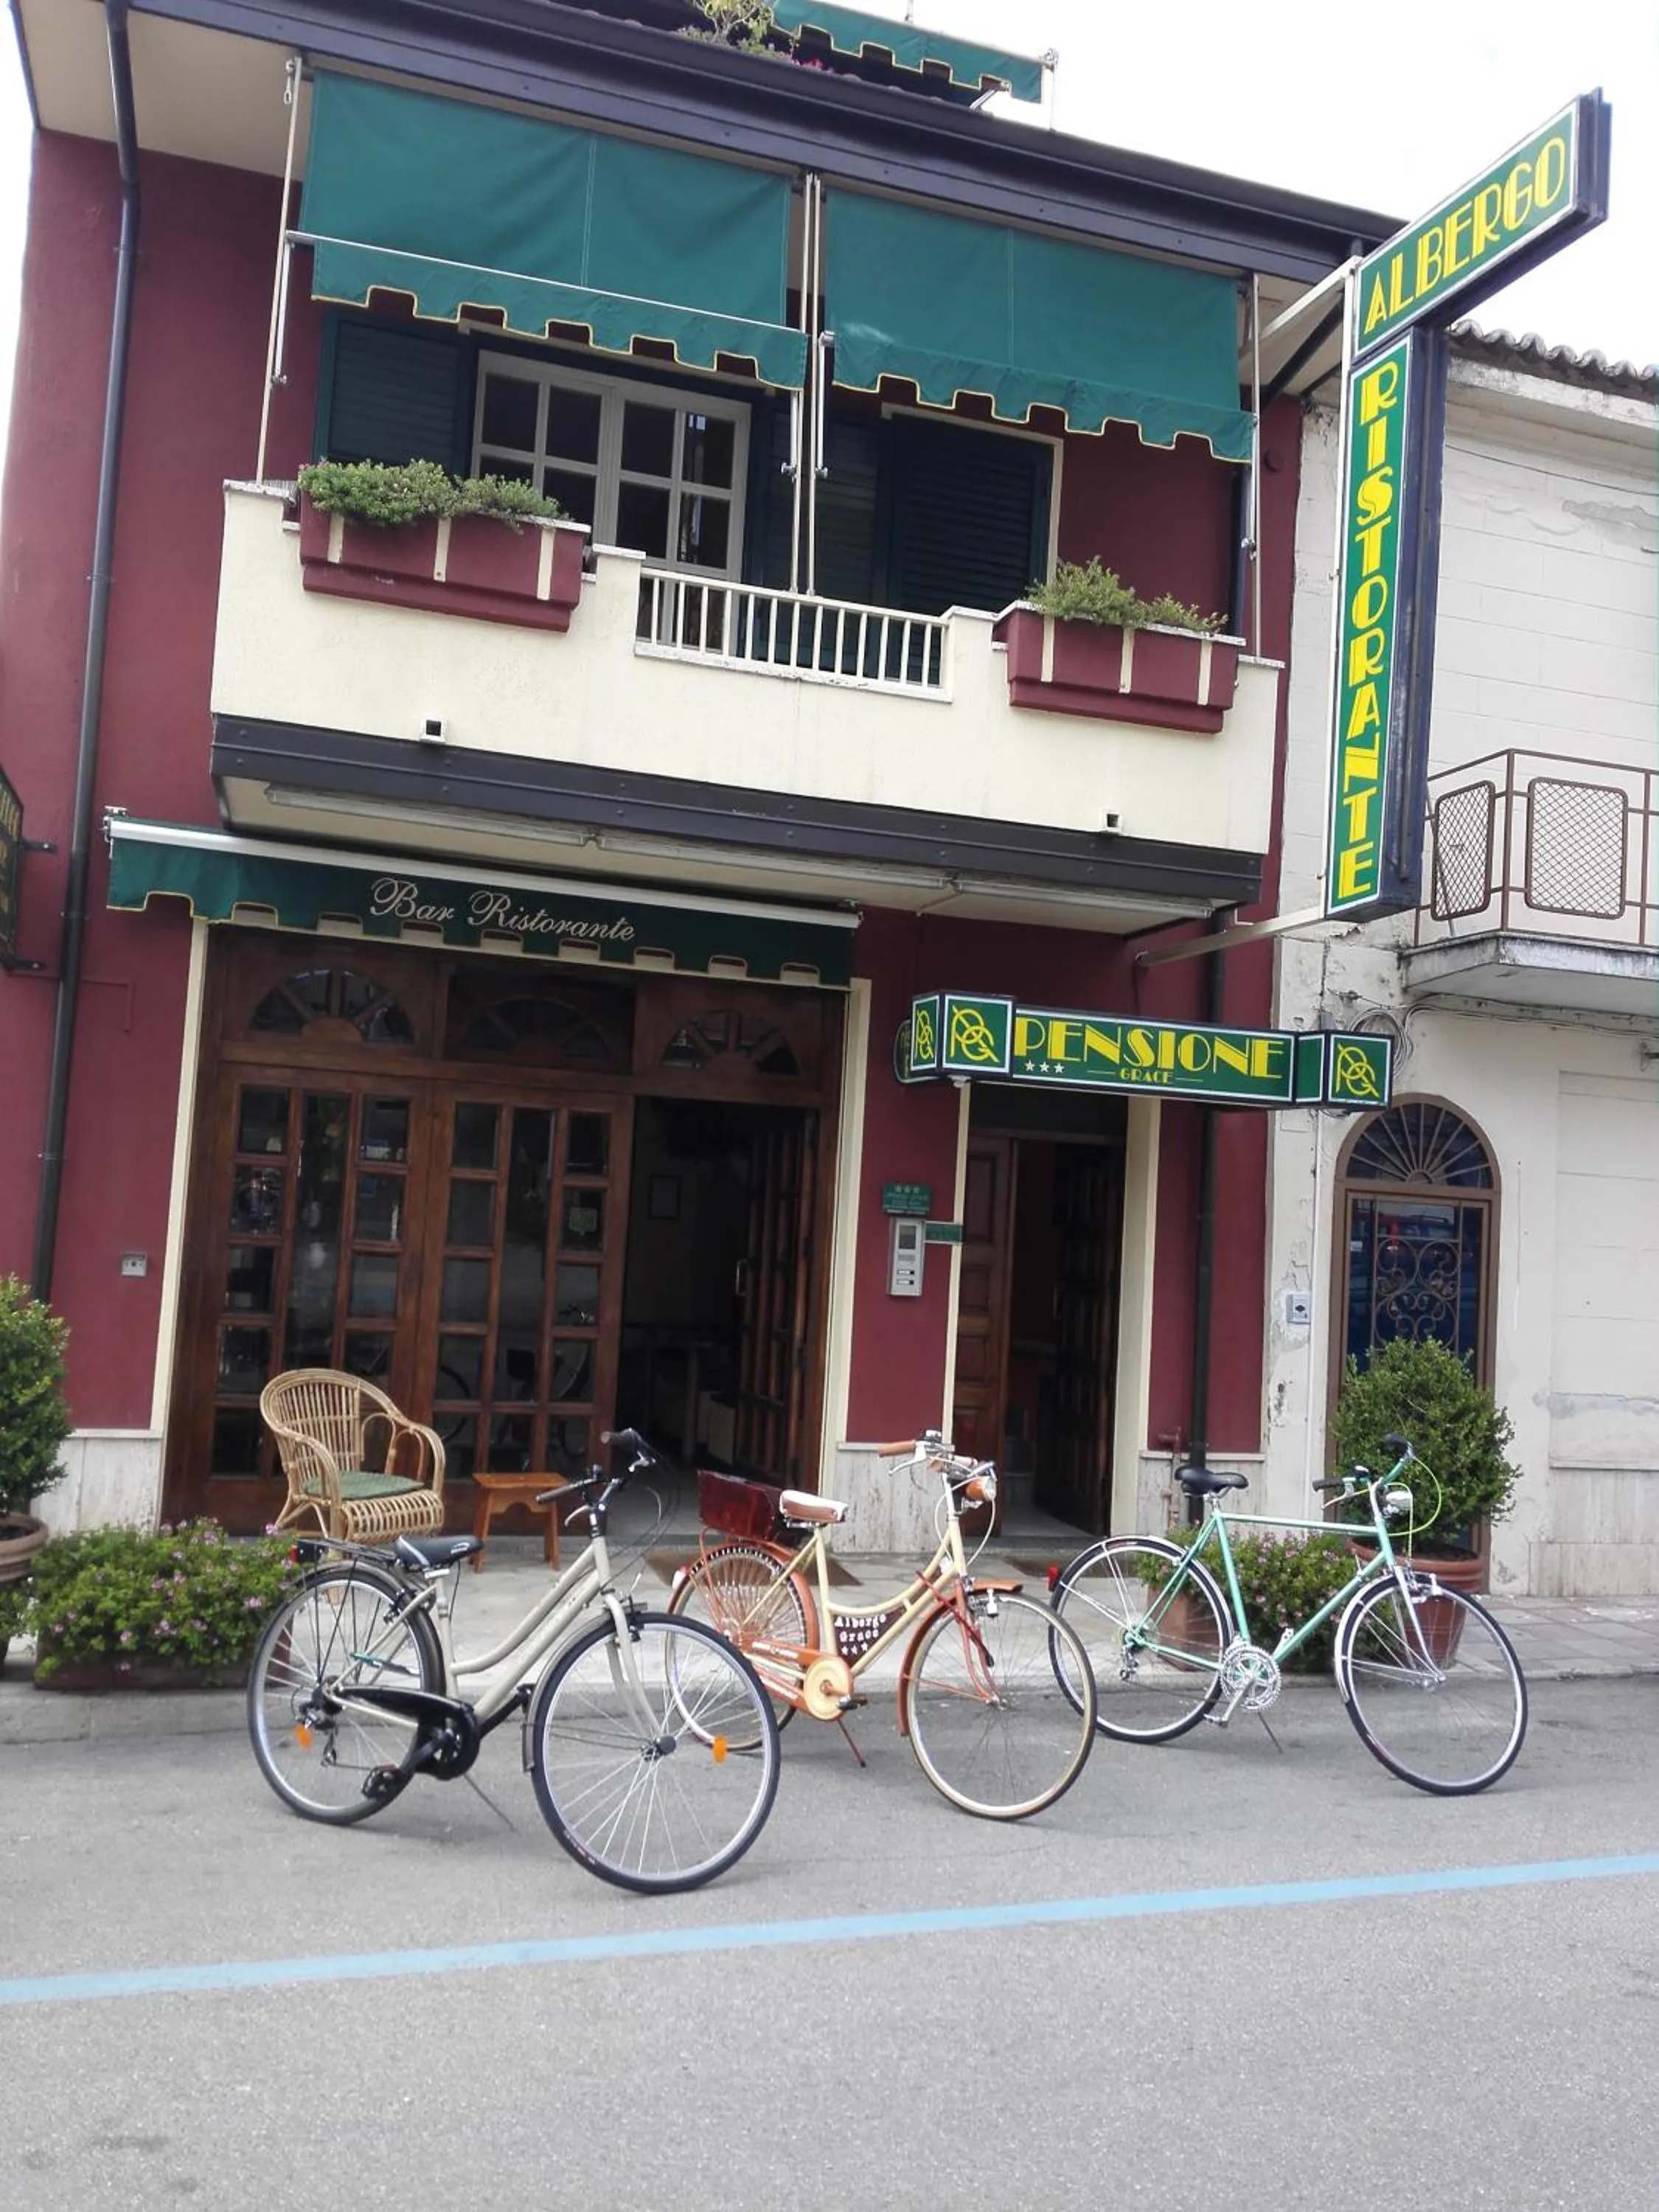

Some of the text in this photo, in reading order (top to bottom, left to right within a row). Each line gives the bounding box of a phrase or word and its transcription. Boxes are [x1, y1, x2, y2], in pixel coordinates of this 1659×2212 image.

[1363, 136, 1566, 335] ALBERGO
[1338, 361, 1399, 900] RISTORANTE
[370, 877, 636, 942] Bar Ristorante
[1013, 1017, 1285, 1079] PENSIONE
[1119, 1068, 1174, 1085] GRACE
